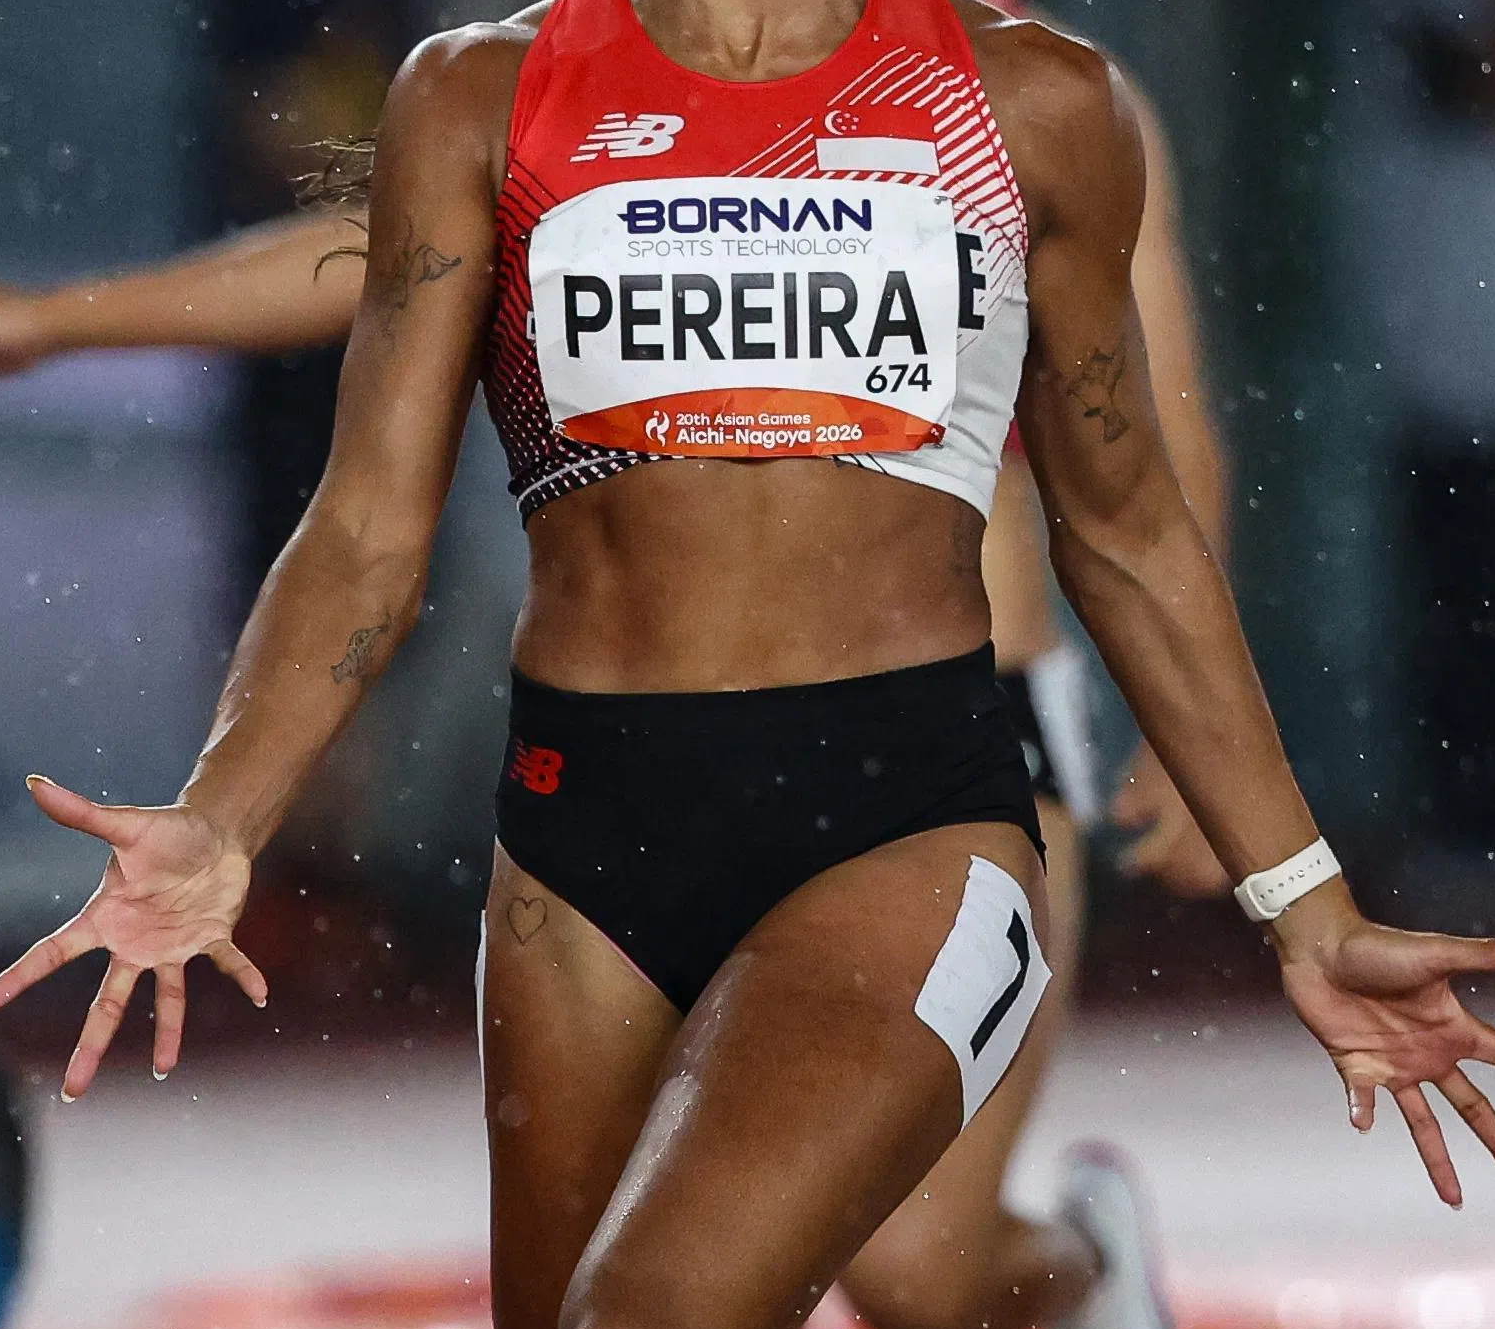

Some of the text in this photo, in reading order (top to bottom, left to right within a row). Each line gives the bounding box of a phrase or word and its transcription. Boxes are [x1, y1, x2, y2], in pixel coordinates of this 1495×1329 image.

[617, 197, 872, 234] BORNAN
[627, 237, 874, 258] SPORTS TECHNOLOGY
[562, 270, 928, 361] PEREIRA
[865, 363, 932, 394] 674
[676, 411, 811, 426] 20th Asian Games
[676, 424, 863, 448] Aichi-Nagoya 2026
